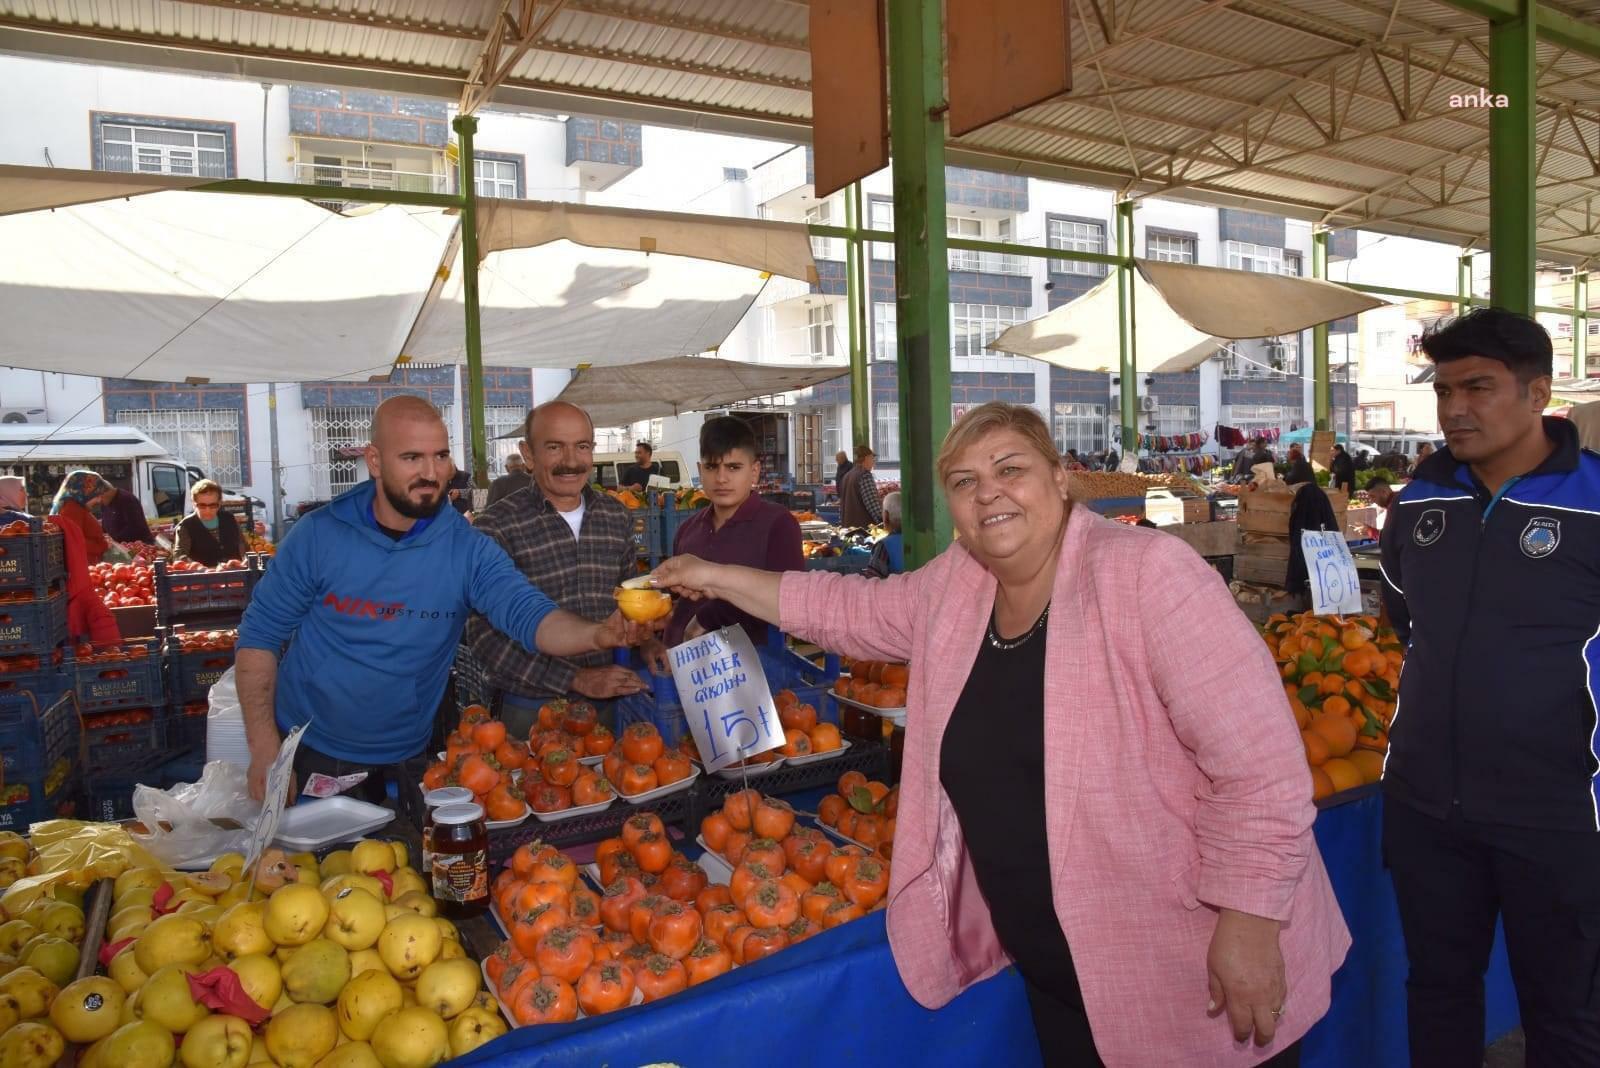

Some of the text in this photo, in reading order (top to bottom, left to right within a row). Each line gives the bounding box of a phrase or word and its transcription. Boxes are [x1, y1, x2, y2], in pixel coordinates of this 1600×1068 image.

[420, 610, 440, 619] DO
[446, 611, 457, 619] IT
[675, 635, 722, 668] HATAY
